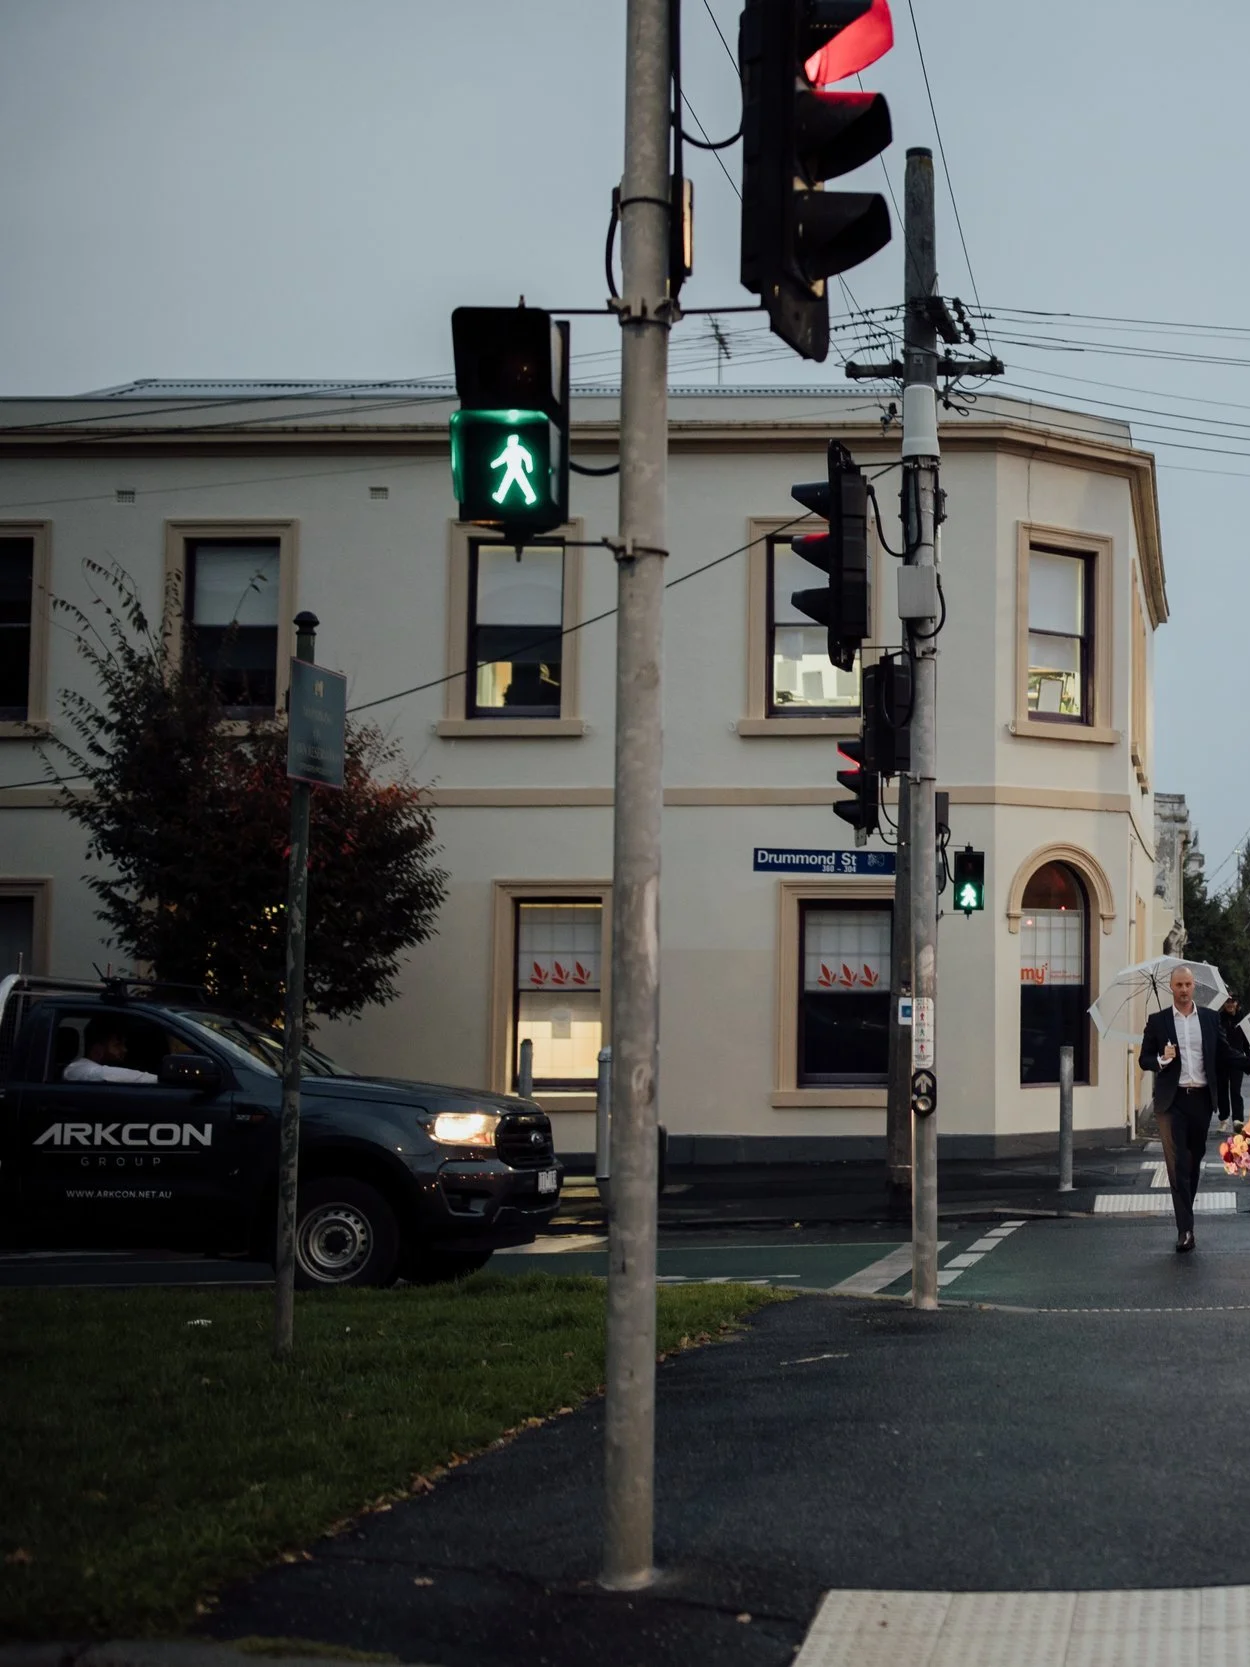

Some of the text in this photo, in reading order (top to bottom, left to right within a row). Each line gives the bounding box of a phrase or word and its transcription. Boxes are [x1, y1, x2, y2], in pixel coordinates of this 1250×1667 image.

[757, 850, 857, 866] Drummond St
[32, 1123, 213, 1146] ARKCON
[81, 1157, 161, 1167] GROUP
[66, 1190, 172, 1199] WWW.ARKCON.NET.AU
